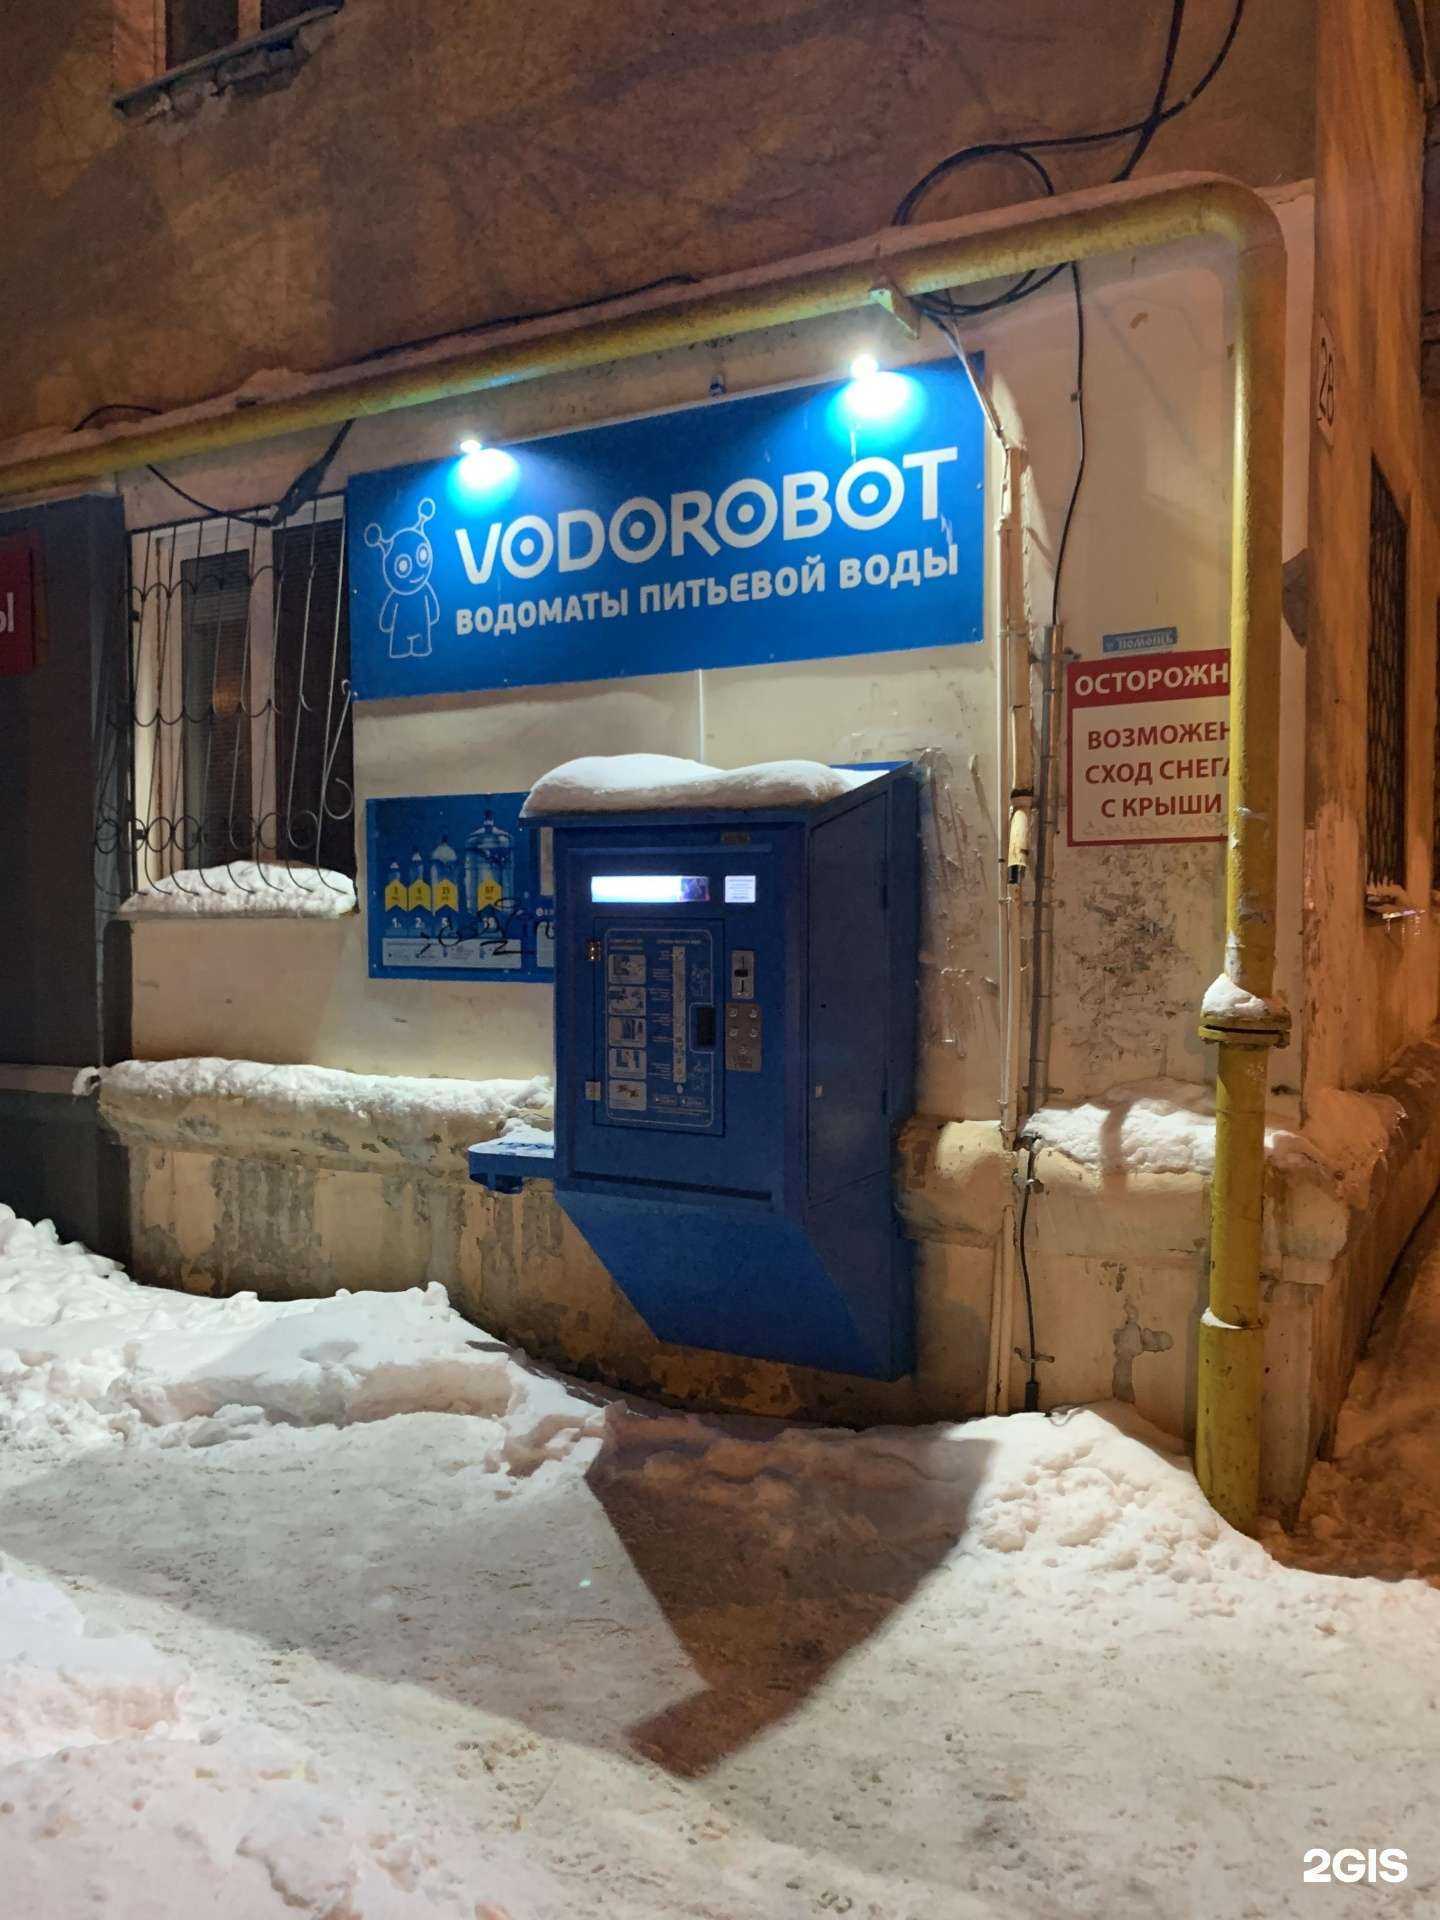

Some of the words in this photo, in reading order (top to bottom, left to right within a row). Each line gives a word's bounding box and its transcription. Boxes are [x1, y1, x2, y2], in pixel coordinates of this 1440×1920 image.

[455, 446, 959, 585] VODOROBOT
[456, 588, 629, 636] ВОДОМАТЫ
[639, 556, 826, 614] ПИТЬЕВОЙ
[838, 544, 959, 589] ВОДЫ
[1085, 762, 1154, 786] СХОД
[1101, 799, 1116, 818] С
[1122, 793, 1222, 818] КРЫШИ
